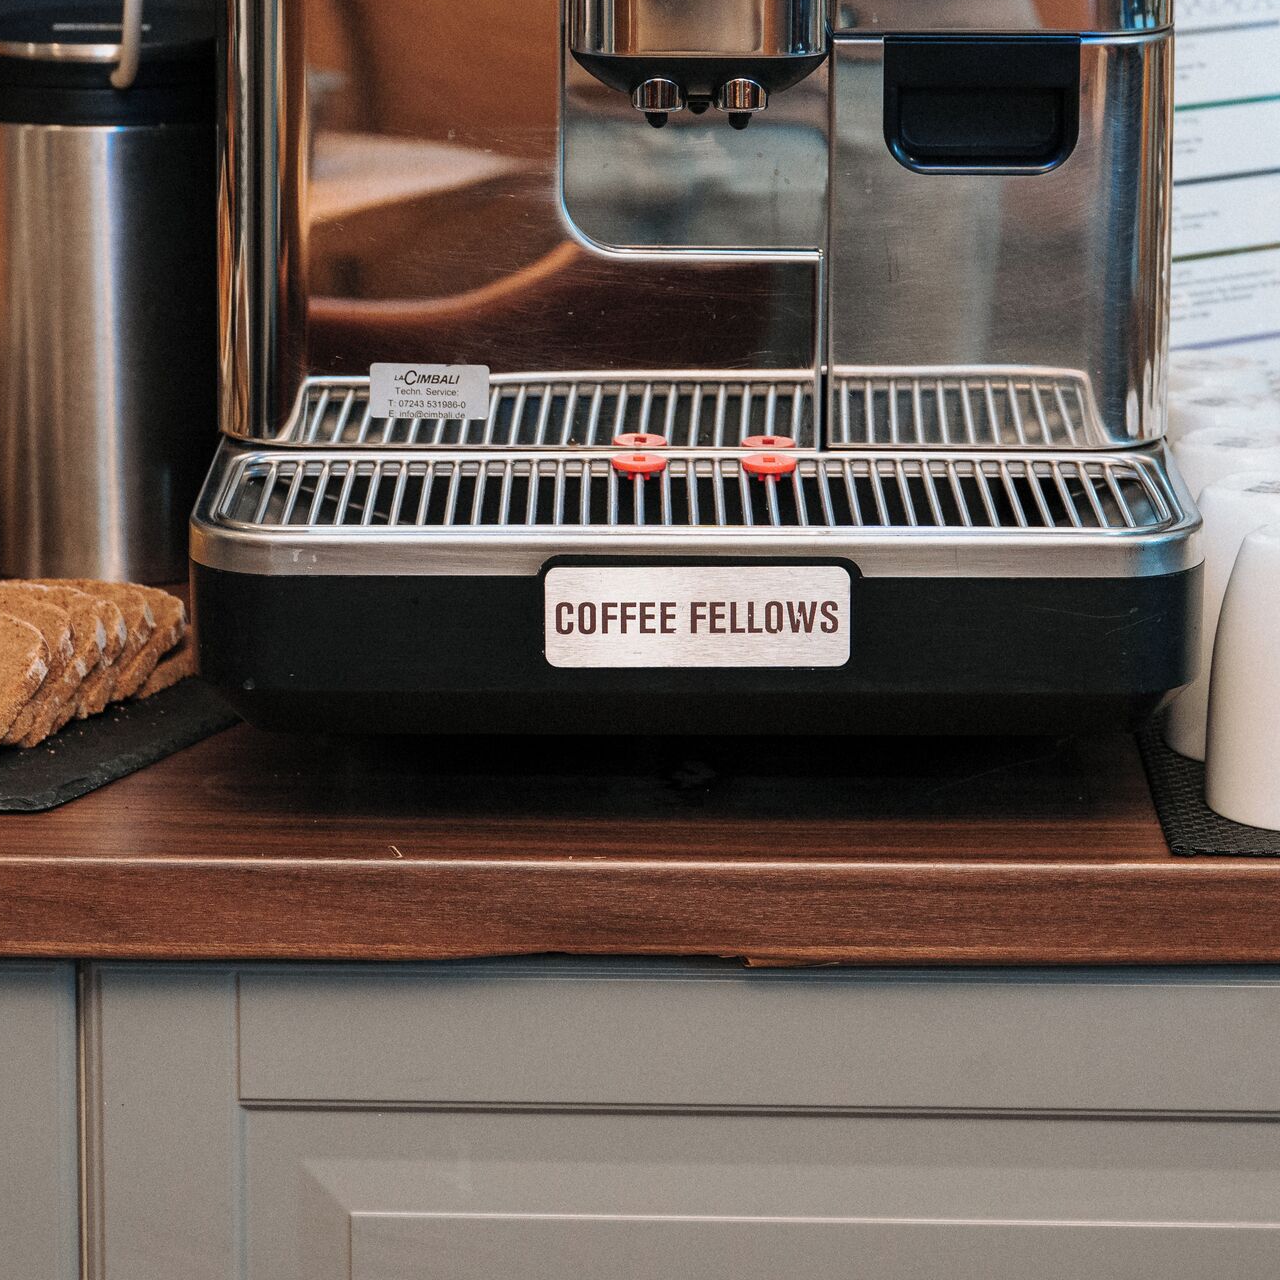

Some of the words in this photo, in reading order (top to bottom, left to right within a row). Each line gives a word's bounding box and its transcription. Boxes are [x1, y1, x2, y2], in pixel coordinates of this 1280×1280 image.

[404, 370, 460, 385] CIMBALI
[395, 387, 422, 396] Techn.
[426, 388, 459, 396] Service:
[399, 400, 424, 408] 07243
[427, 401, 466, 409] 531986-0
[555, 602, 677, 634] COFFEE
[690, 601, 839, 634] FELLOWS
